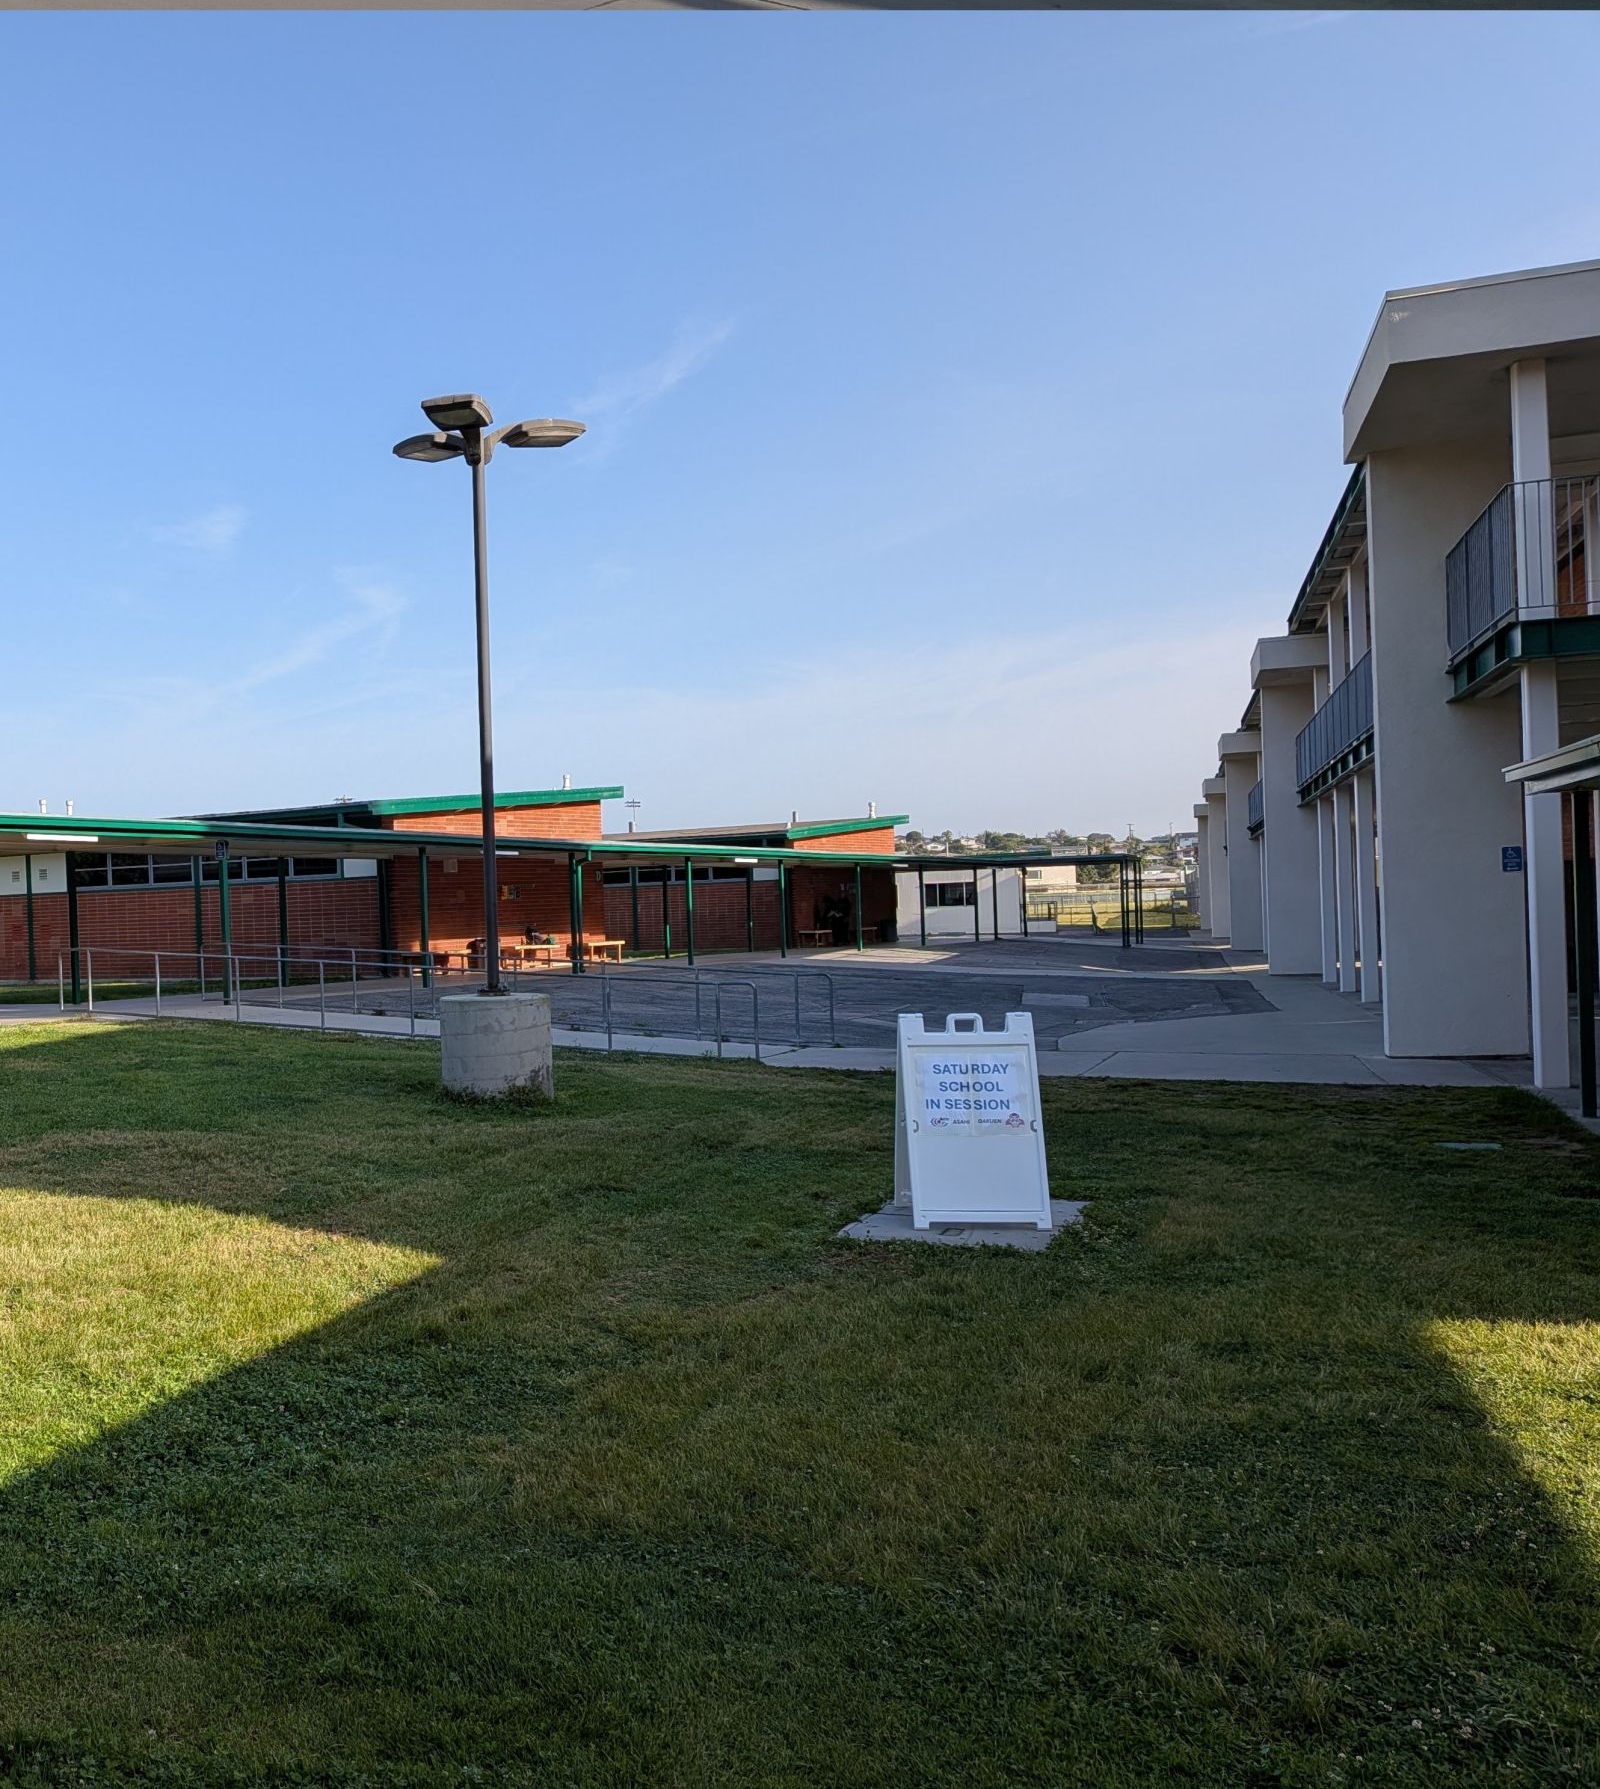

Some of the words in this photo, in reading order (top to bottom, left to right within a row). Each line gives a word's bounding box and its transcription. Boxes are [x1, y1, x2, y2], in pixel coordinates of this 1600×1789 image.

[932, 1063, 1009, 1075] SATURDAY
[939, 1081, 1004, 1092] SCHOOL
[925, 1098, 941, 1110] IN
[944, 1099, 1010, 1110] SESSION
